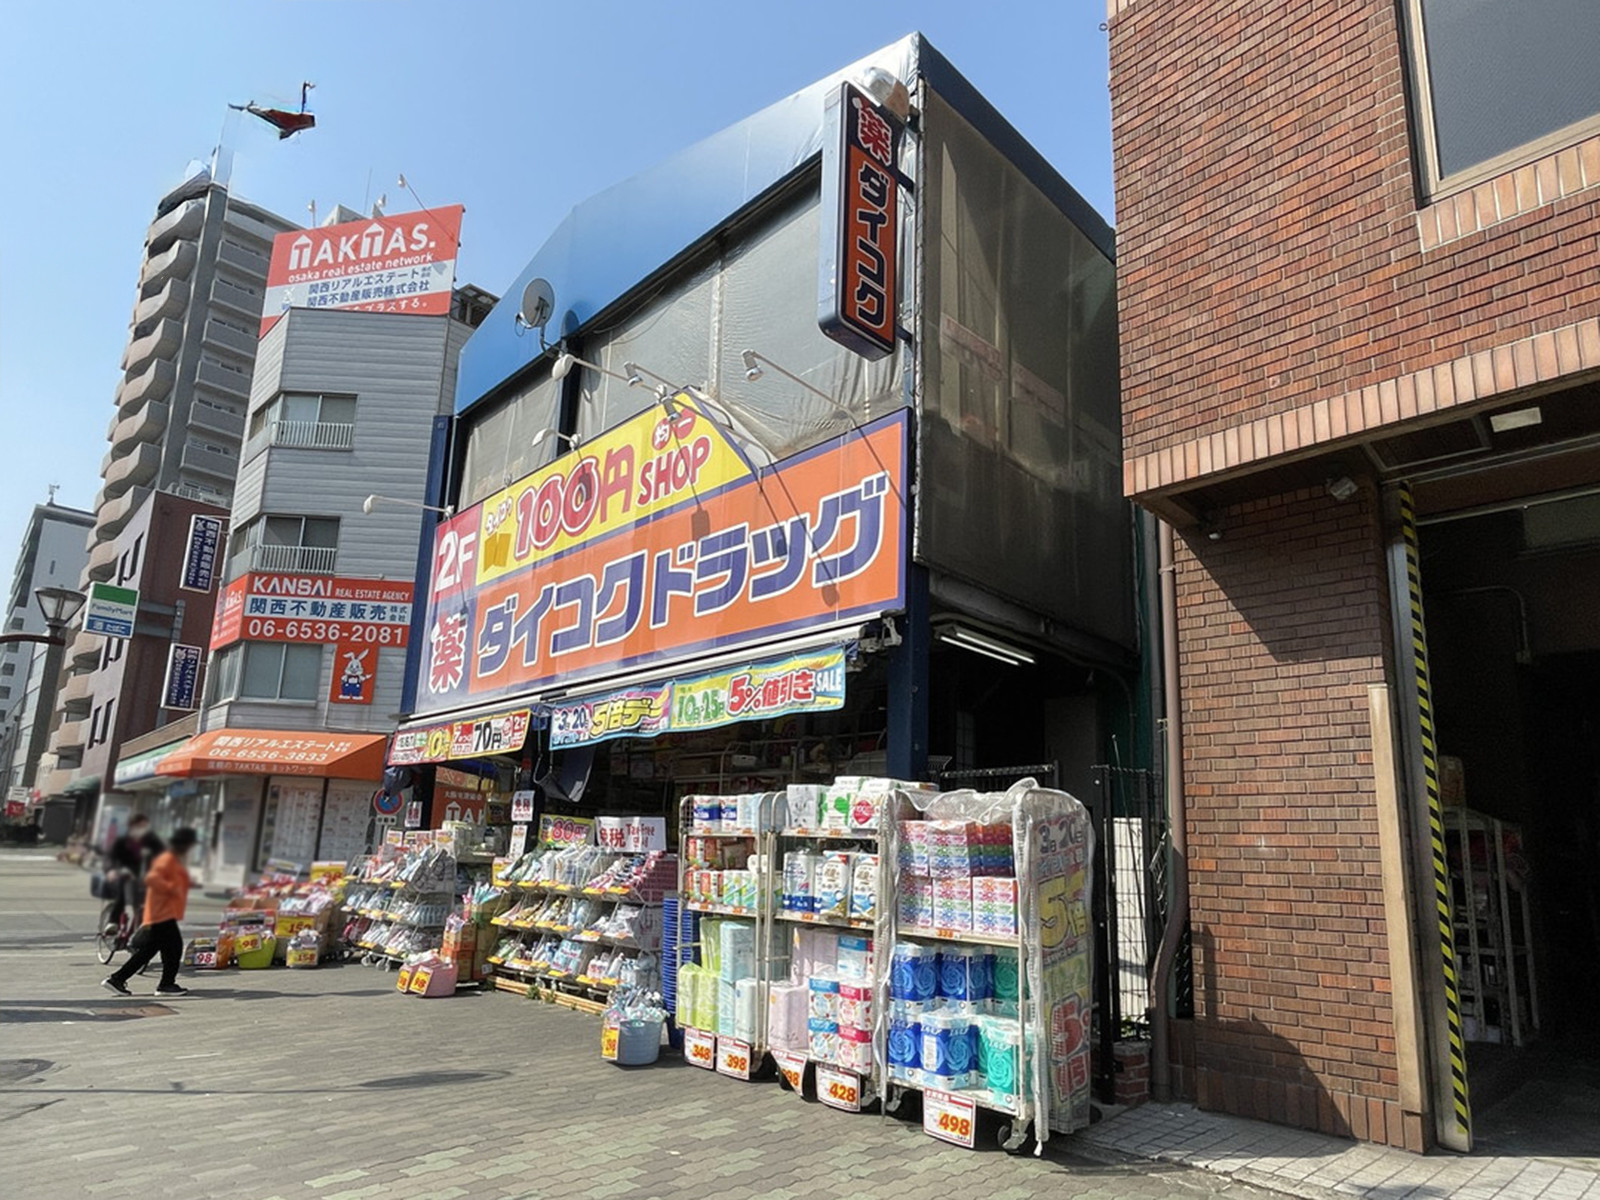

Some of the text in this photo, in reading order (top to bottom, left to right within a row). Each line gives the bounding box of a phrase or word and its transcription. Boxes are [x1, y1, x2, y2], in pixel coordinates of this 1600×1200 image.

[853, 98, 892, 167] 薬
[854, 161, 890, 329] ダイコク
[288, 252, 434, 284] osaka real estate network
[308, 269, 420, 295] 関西リアルエステート
[636, 435, 711, 506] SHOP
[514, 444, 635, 560] 100円
[435, 528, 477, 592] 2F
[477, 471, 889, 678] ダイコクドラッグ
[253, 576, 410, 601] KANSAI REAL ESTATE AGENCY
[92, 603, 133, 616] FamilyMart
[249, 598, 387, 621] 関西不動産販売
[248, 619, 403, 644] 06-6536-2081
[429, 612, 466, 695] 薬
[730, 668, 842, 713] 5%値引き SALE
[514, 716, 527, 730] 2F
[209, 748, 328, 762] 06-6536-3833
[212, 735, 336, 752] 関西リアルエステート
[197, 953, 213, 964] 98
[693, 1044, 711, 1061] 348
[727, 1054, 747, 1071] 398
[829, 1083, 857, 1103] 428
[939, 1113, 971, 1137] 498
